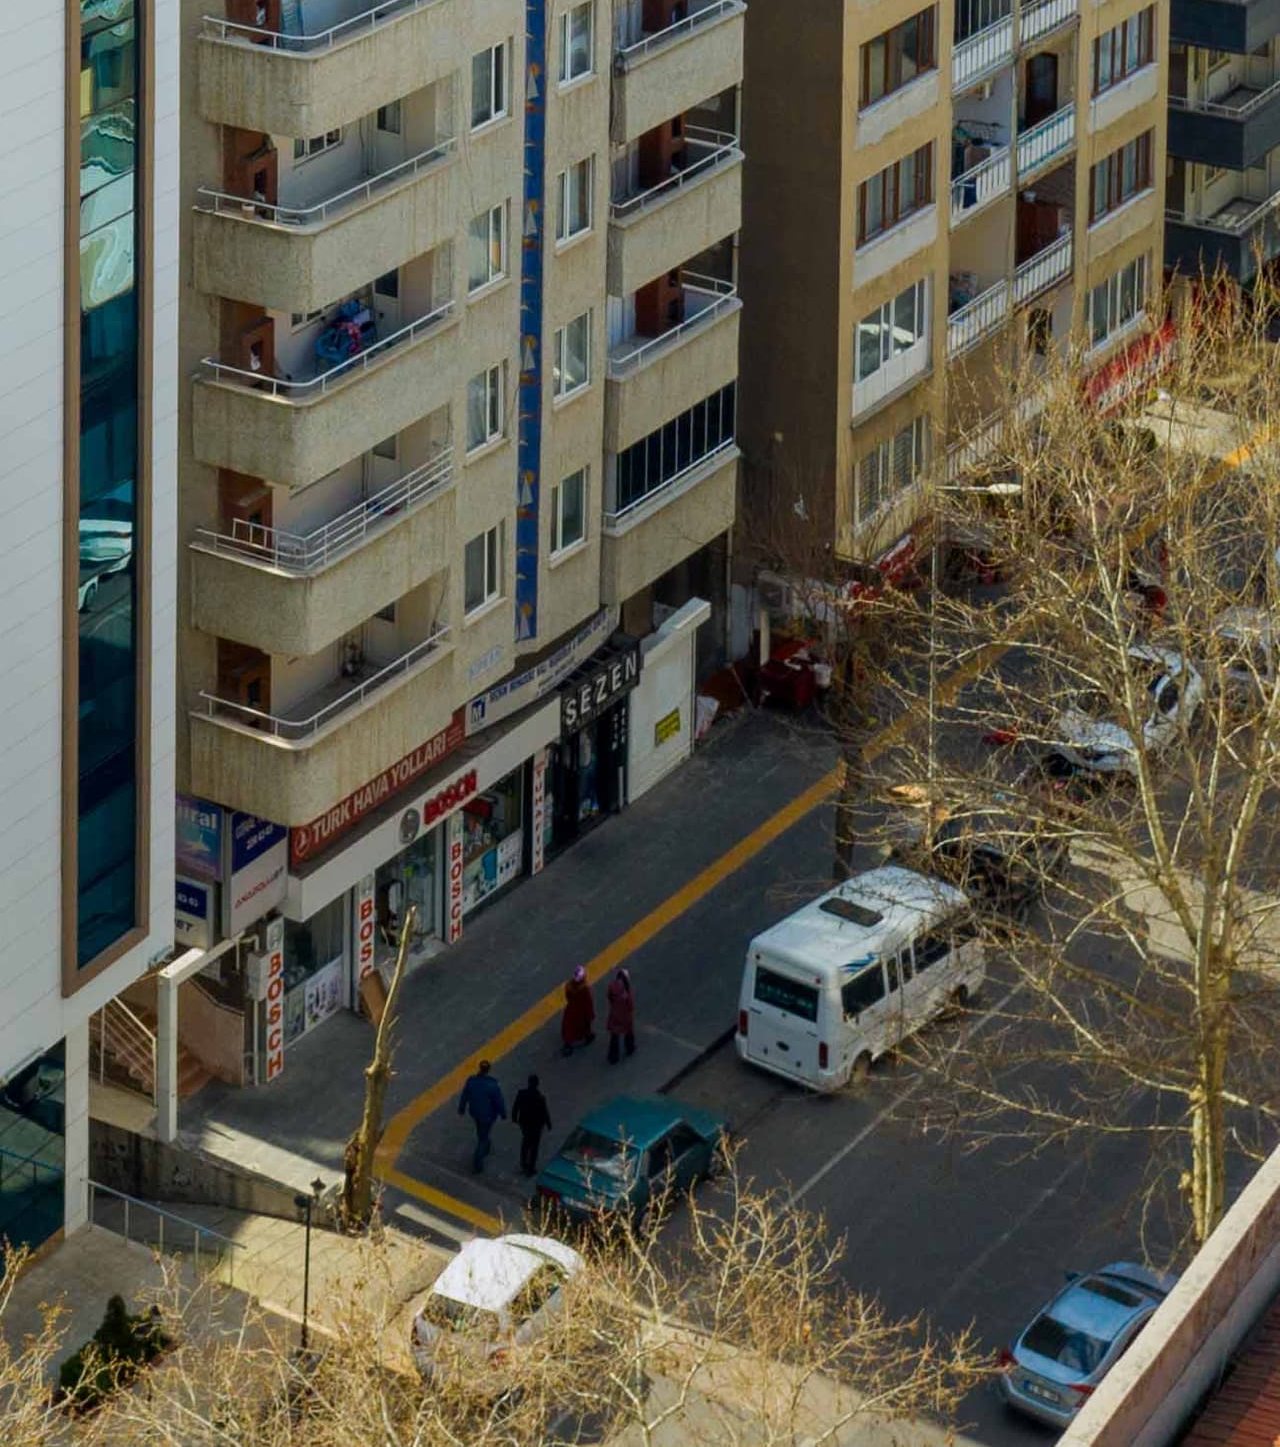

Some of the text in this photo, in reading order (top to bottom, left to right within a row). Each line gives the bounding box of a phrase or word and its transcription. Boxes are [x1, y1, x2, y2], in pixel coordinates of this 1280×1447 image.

[565, 650, 638, 726] SEZEN
[353, 773, 389, 815] HAVA
[391, 732, 447, 786] YOLLARI
[450, 841, 462, 942] BOSCH
[359, 898, 373, 980] BOSC
[267, 952, 283, 1081] BOSCH
